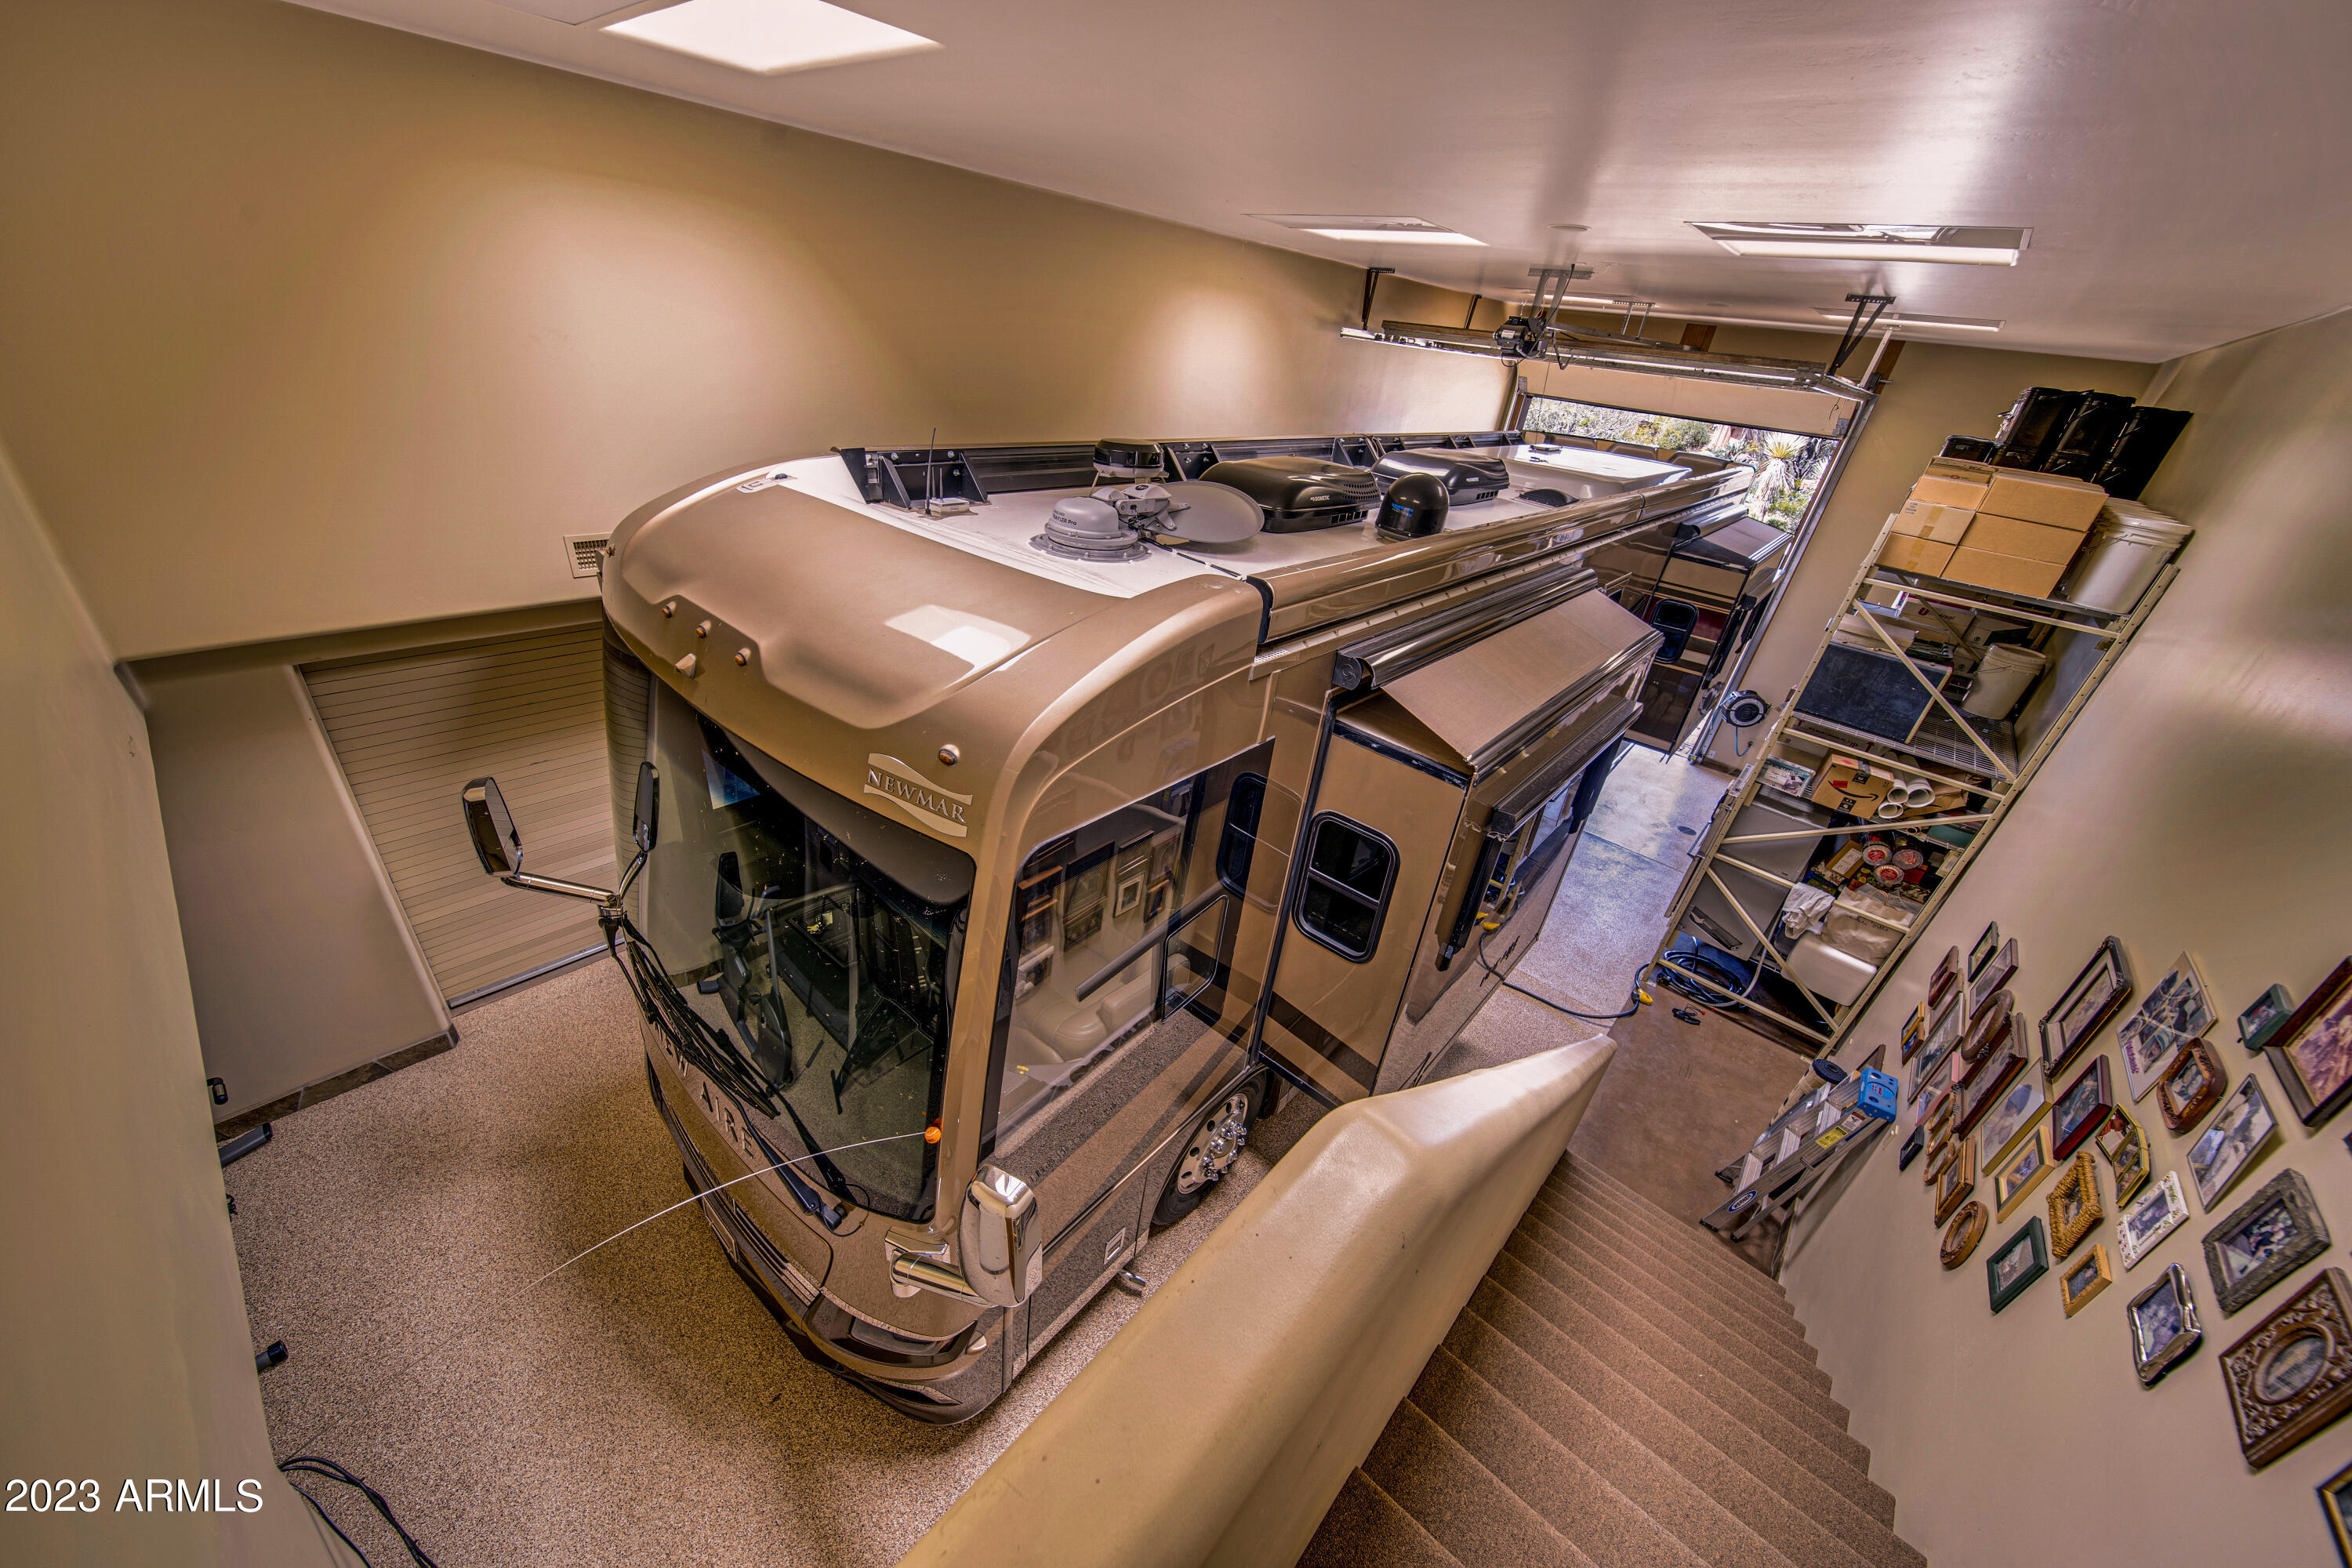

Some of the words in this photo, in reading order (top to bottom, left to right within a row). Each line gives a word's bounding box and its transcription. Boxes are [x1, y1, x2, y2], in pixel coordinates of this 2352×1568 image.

[1918, 607, 1956, 620] Unersal
[867, 768, 967, 824] NEWMAR
[700, 1081, 754, 1159] AIRE
[1733, 1193, 1751, 1208] WERNER
